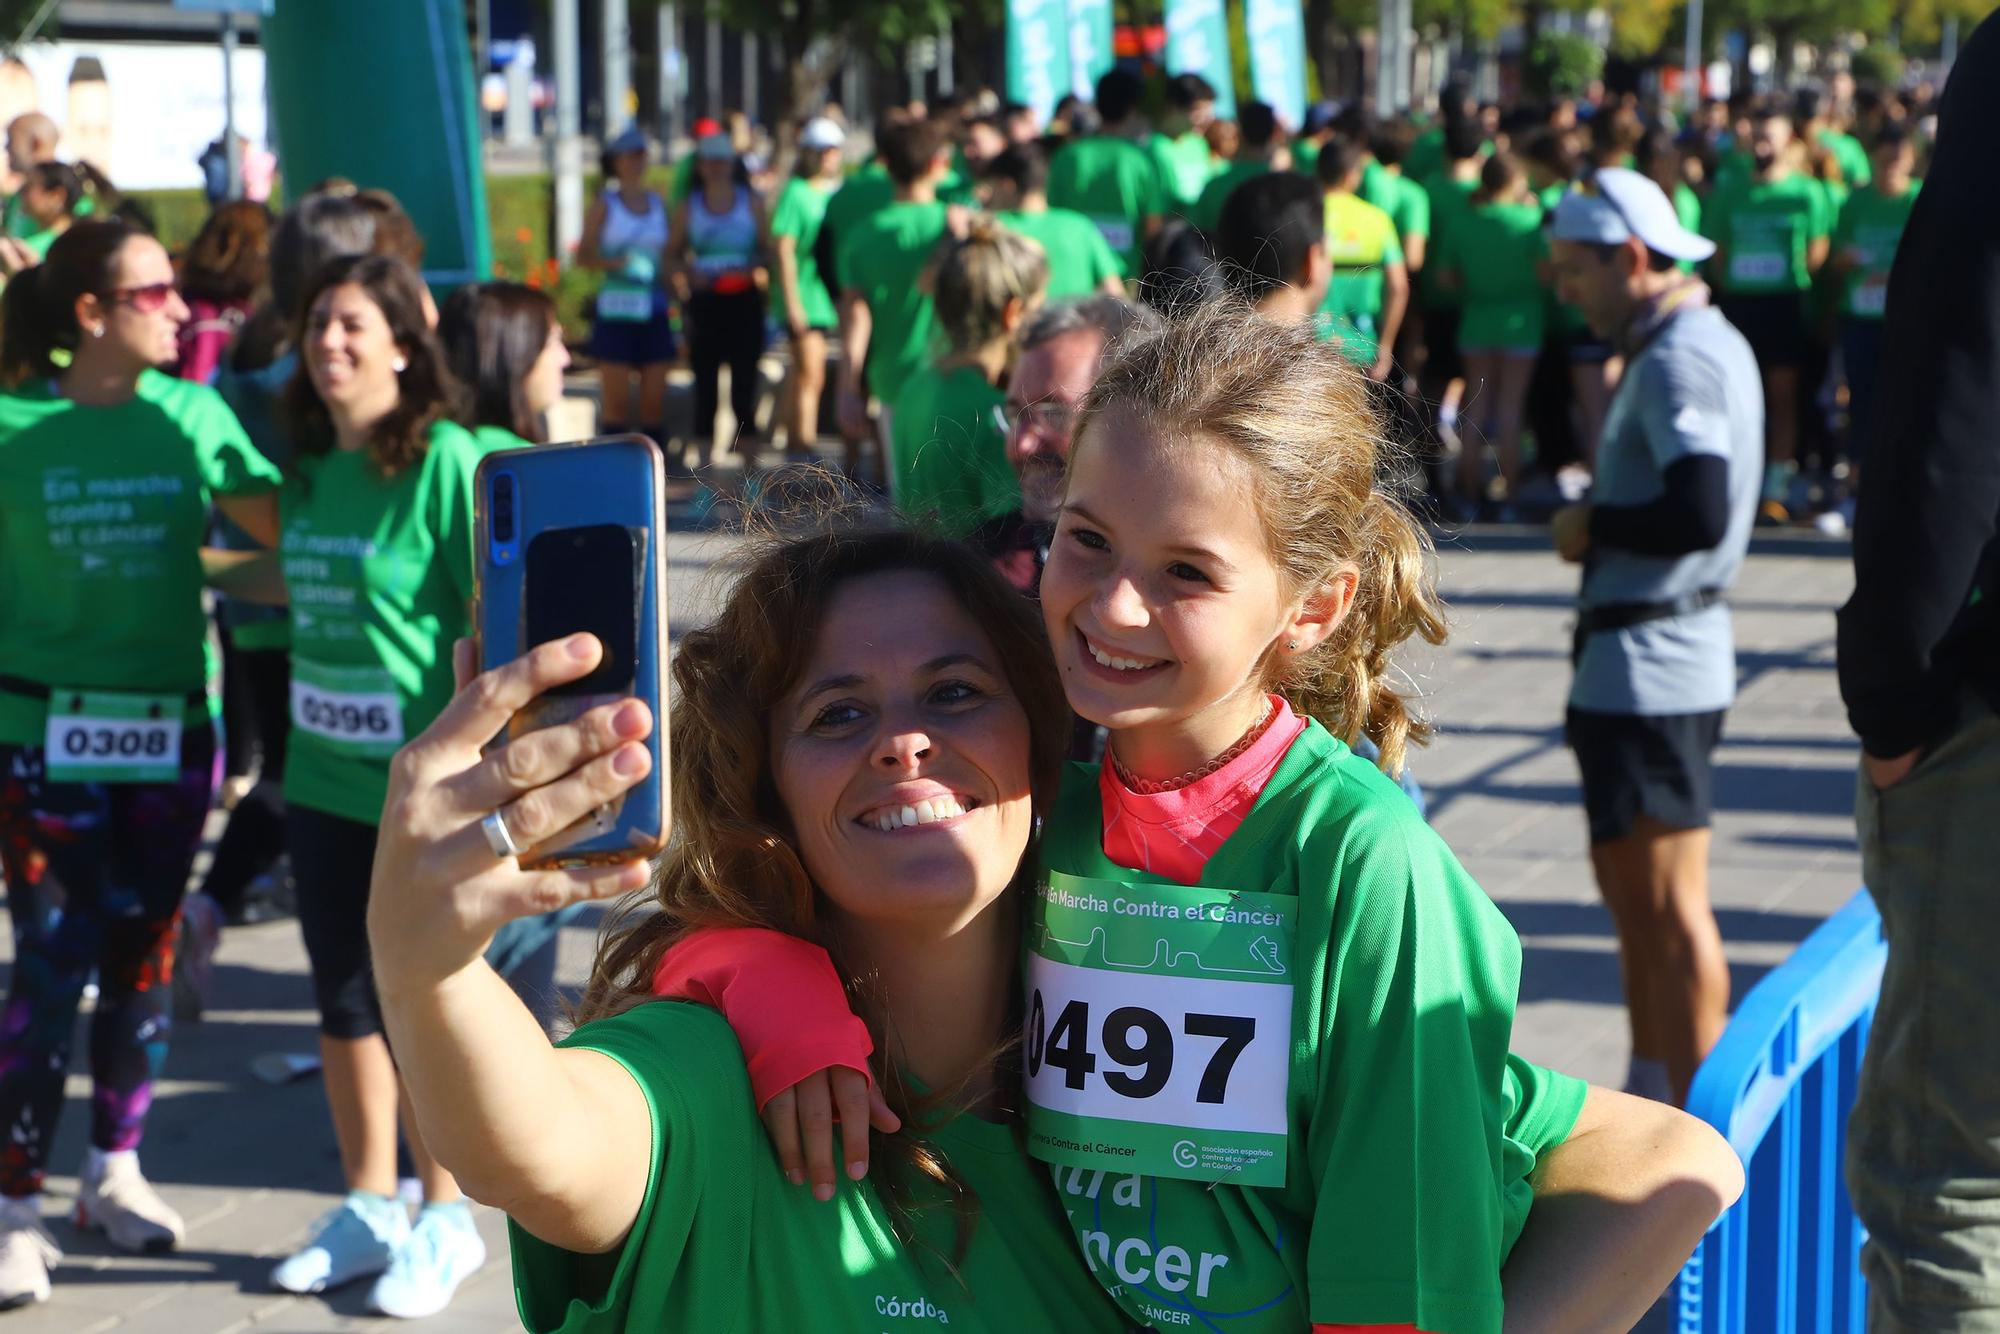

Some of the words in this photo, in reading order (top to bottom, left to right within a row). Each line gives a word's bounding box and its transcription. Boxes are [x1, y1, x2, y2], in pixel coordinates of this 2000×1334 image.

[44, 479, 80, 501] En
[87, 477, 182, 496] marcha
[48, 502, 133, 523] contra
[303, 696, 390, 735] 0396
[65, 726, 167, 757] 0308
[1058, 889, 1109, 913] Marcha
[1113, 897, 1179, 919] Contra
[1185, 903, 1205, 921] el
[1210, 905, 1283, 926] Cáncer
[1028, 988, 1256, 1104] 0497
[1051, 1136, 1080, 1152] Contra
[1083, 1142, 1093, 1153] el
[1096, 1143, 1137, 1157] Cáncer
[1202, 1145, 1239, 1155] asociación
[1240, 1148, 1274, 1157] española
[1202, 1153, 1224, 1162] contra
[1225, 1155, 1233, 1163] el
